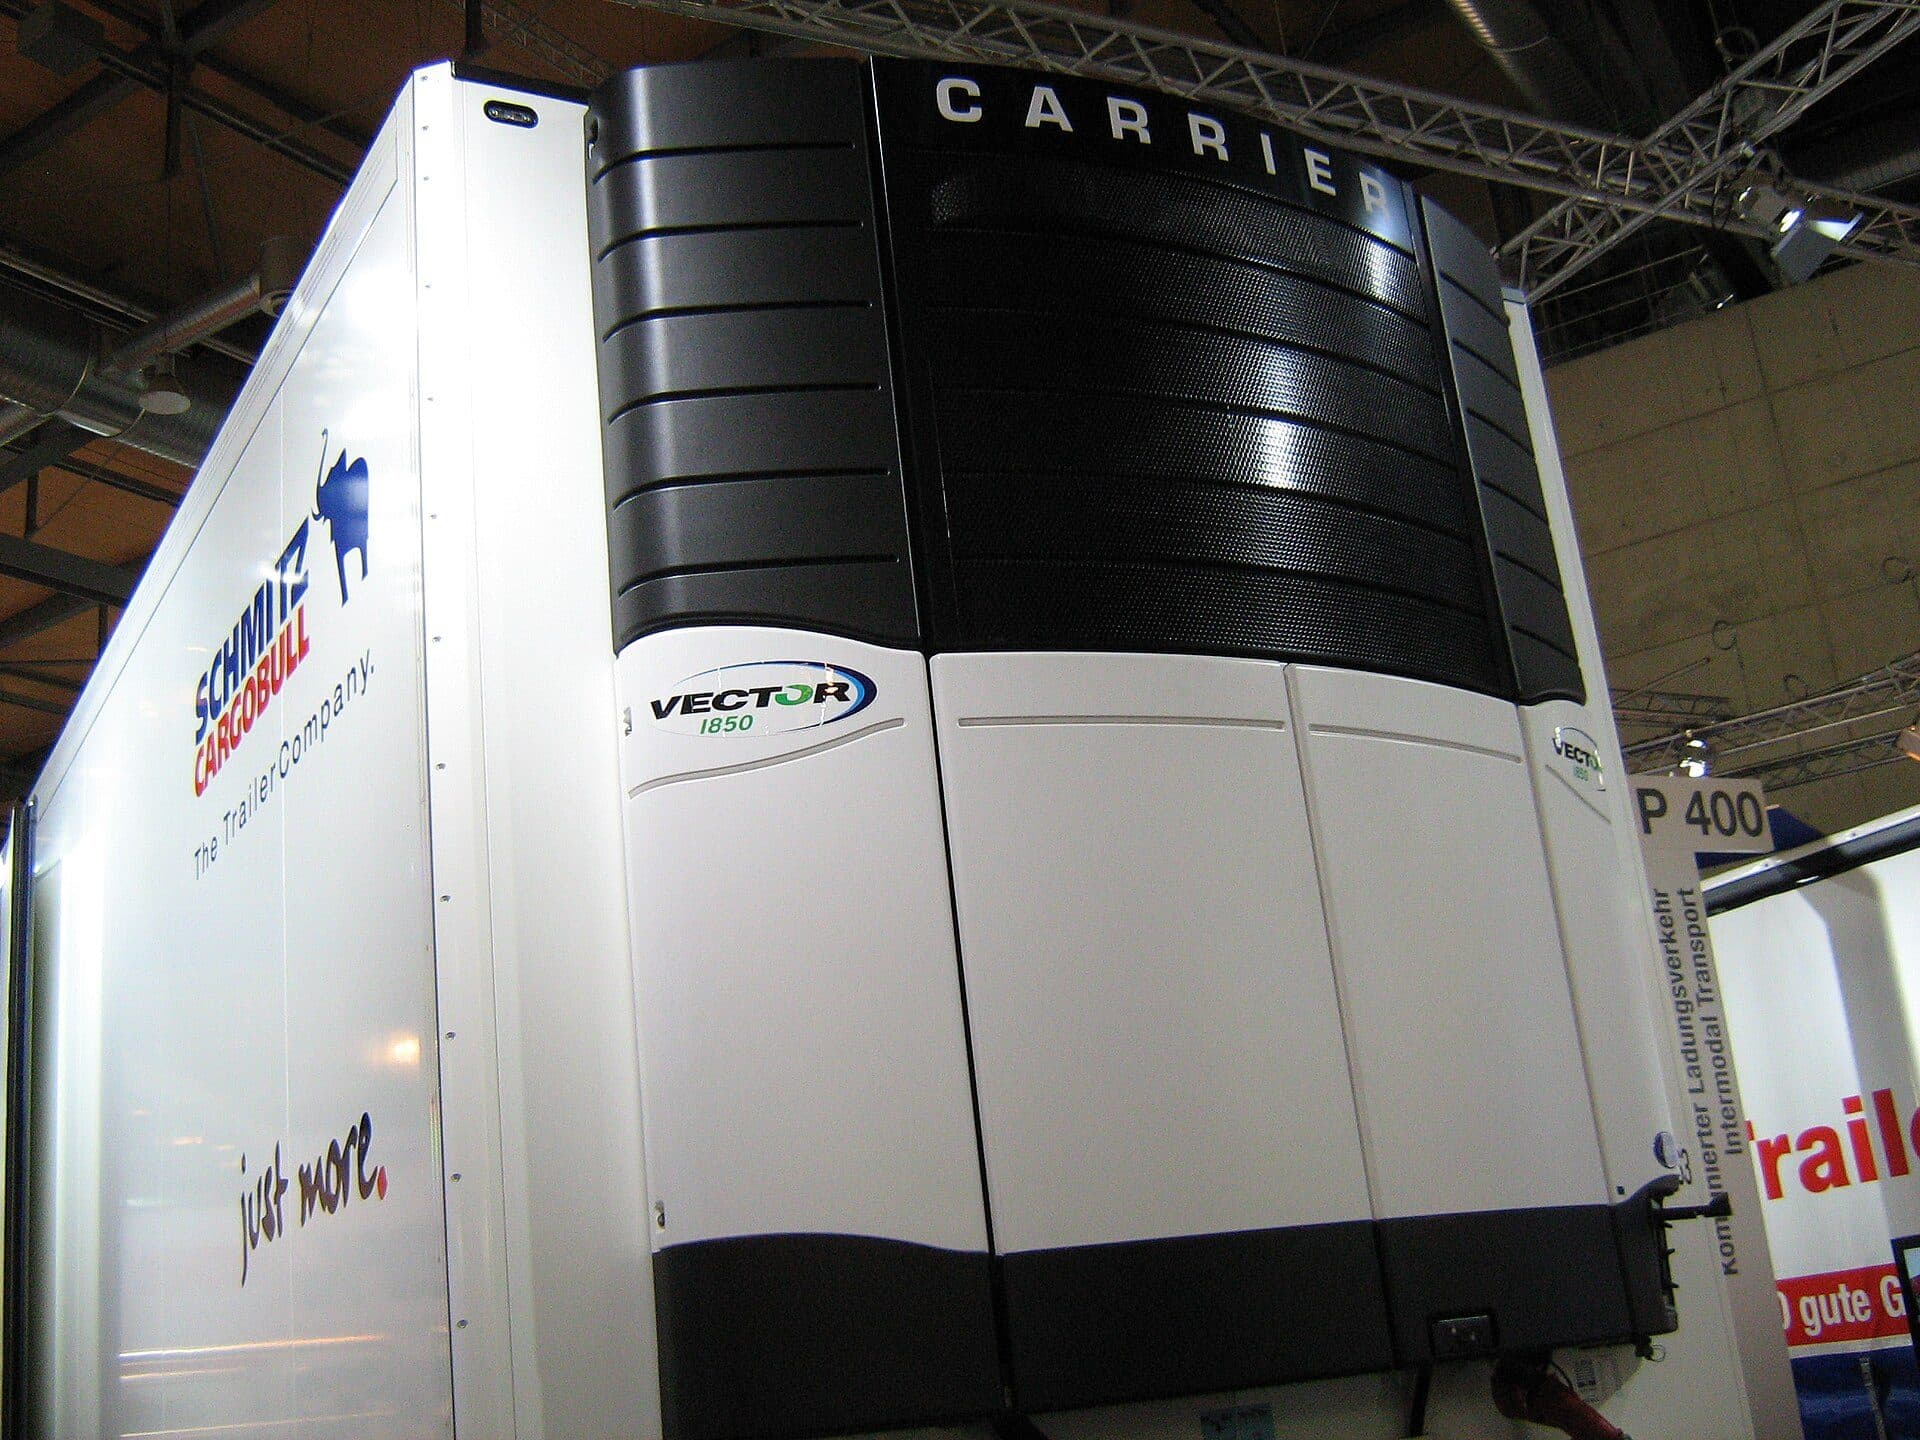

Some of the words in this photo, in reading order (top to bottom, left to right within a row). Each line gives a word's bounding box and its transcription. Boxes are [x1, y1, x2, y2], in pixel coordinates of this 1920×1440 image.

[936, 78, 1390, 213] CARRIER
[195, 514, 309, 745] SCHMITZ
[195, 603, 309, 797] CARGOBULL
[650, 682, 851, 720] VECTOR
[700, 714, 754, 735] 1850
[1552, 738, 1603, 773] VECTO
[194, 836, 218, 880] The
[1636, 788, 1667, 834] P
[1685, 790, 1763, 837] 400
[1653, 888, 1705, 1094] Ladungsverkehr
[1677, 888, 1714, 1007] Transport
[1700, 1016, 1742, 1154] Intermodal
[1745, 1088, 1920, 1200] rail
[240, 1140, 289, 1288] just
[1694, 1102, 1738, 1276] Komnierter
[1800, 1284, 1871, 1337] gute
